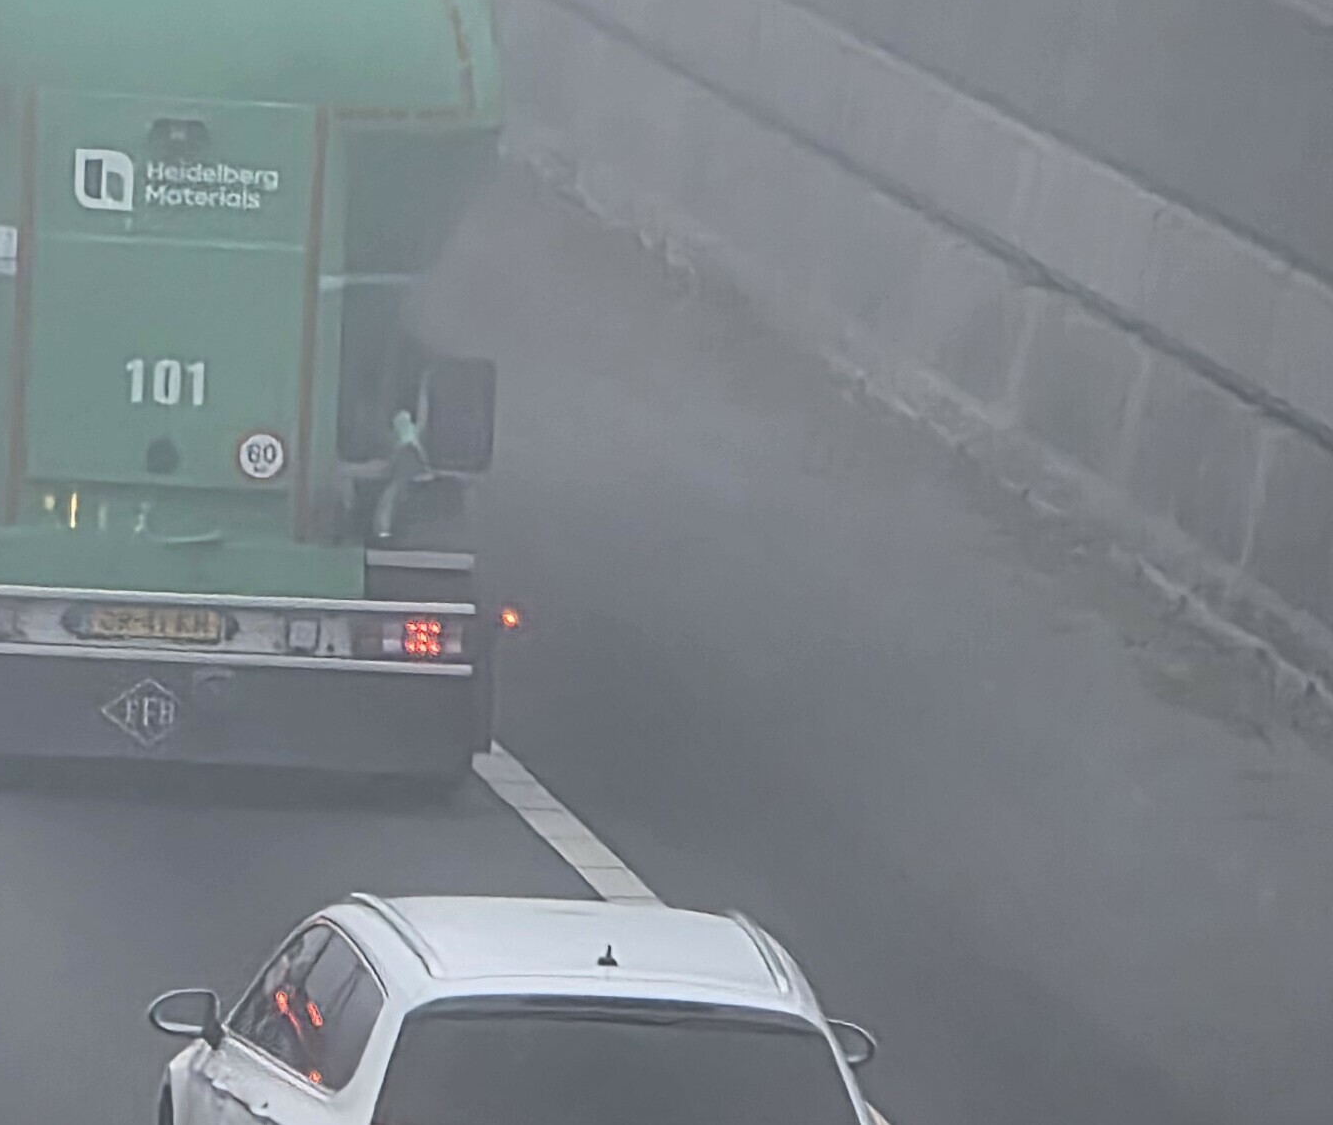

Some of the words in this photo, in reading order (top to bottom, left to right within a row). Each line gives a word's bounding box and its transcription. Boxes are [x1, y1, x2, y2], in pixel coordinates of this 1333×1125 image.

[146, 161, 279, 191] Heidelberg
[144, 183, 262, 209] Materials
[126, 359, 204, 406] 101
